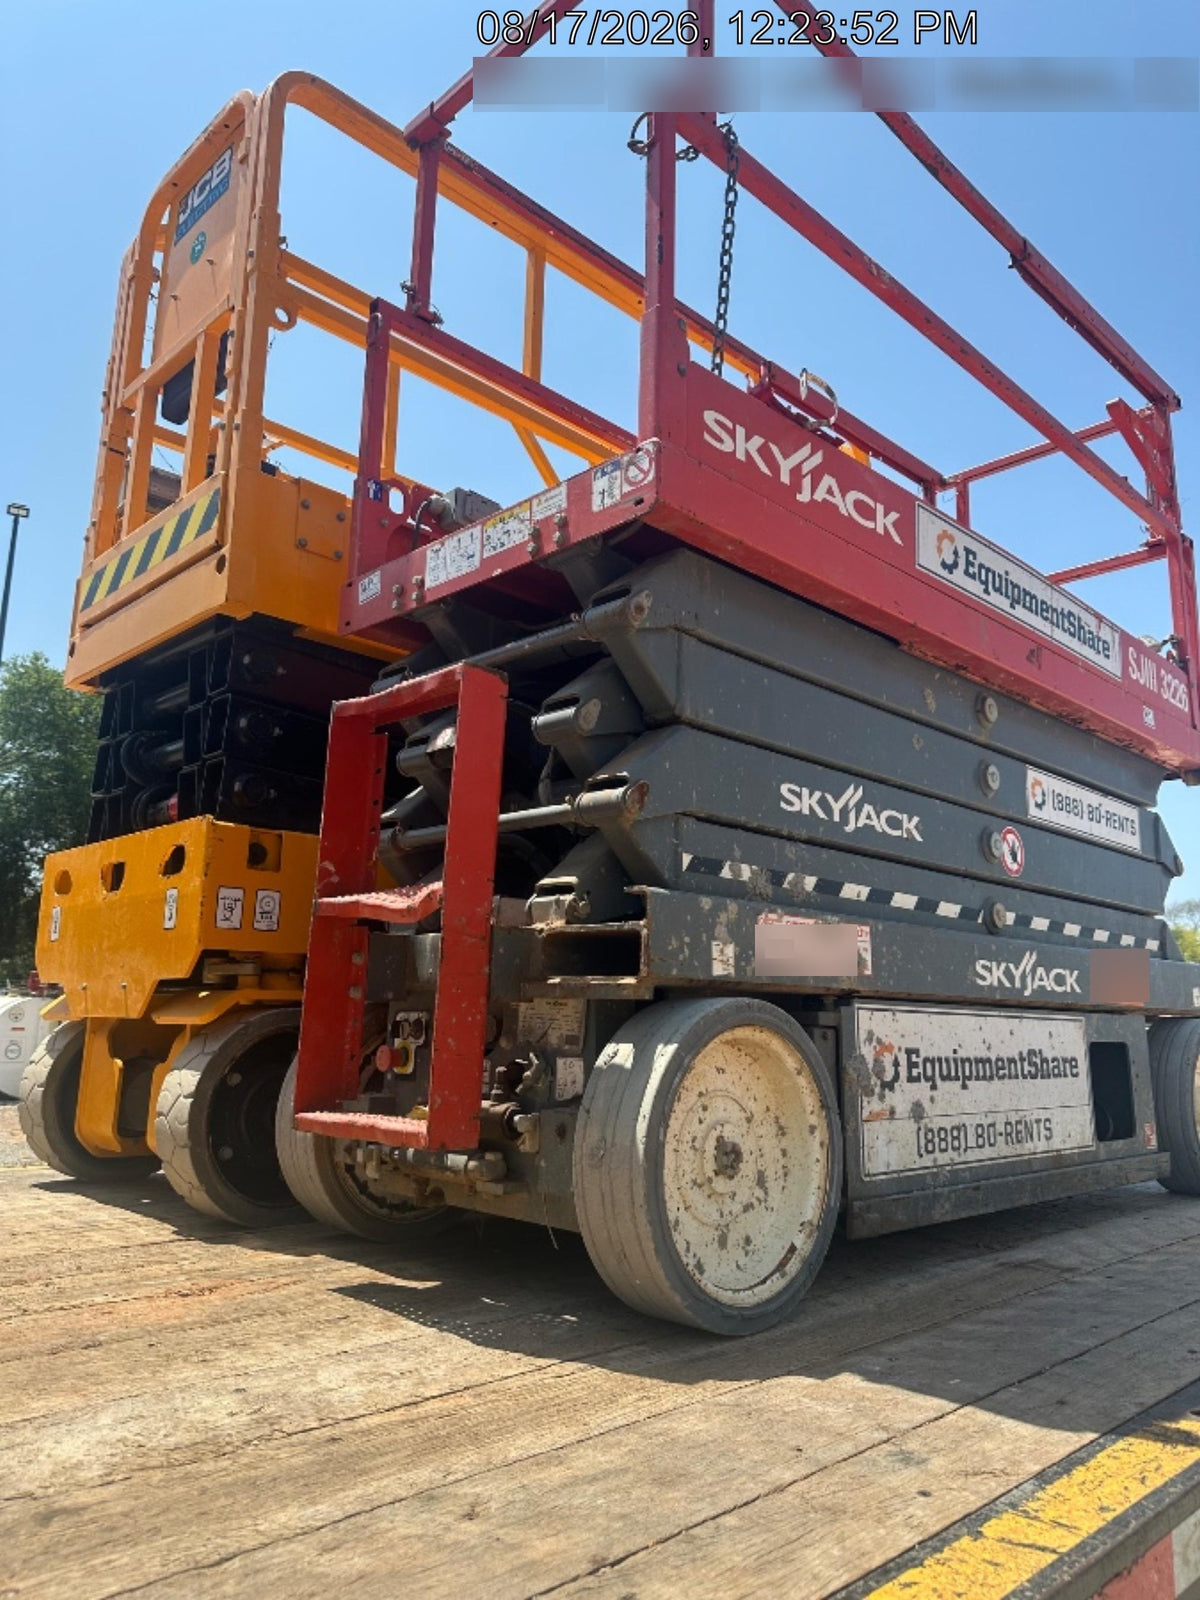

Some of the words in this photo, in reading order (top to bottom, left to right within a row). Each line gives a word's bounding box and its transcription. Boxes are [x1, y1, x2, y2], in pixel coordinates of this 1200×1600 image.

[178, 146, 232, 225] JCB
[703, 410, 904, 546] SKYJACK
[963, 545, 1111, 660] EquipmentShare
[779, 783, 923, 842] SKYJACK
[1051, 789, 1084, 820] (888)
[1087, 803, 1137, 836] 80-RENTS
[975, 950, 1081, 997] SKYJACK
[904, 1047, 1080, 1090] EquipmentShare
[917, 1122, 968, 1158] (888)
[975, 1117, 1054, 1149] 80-RENTS
